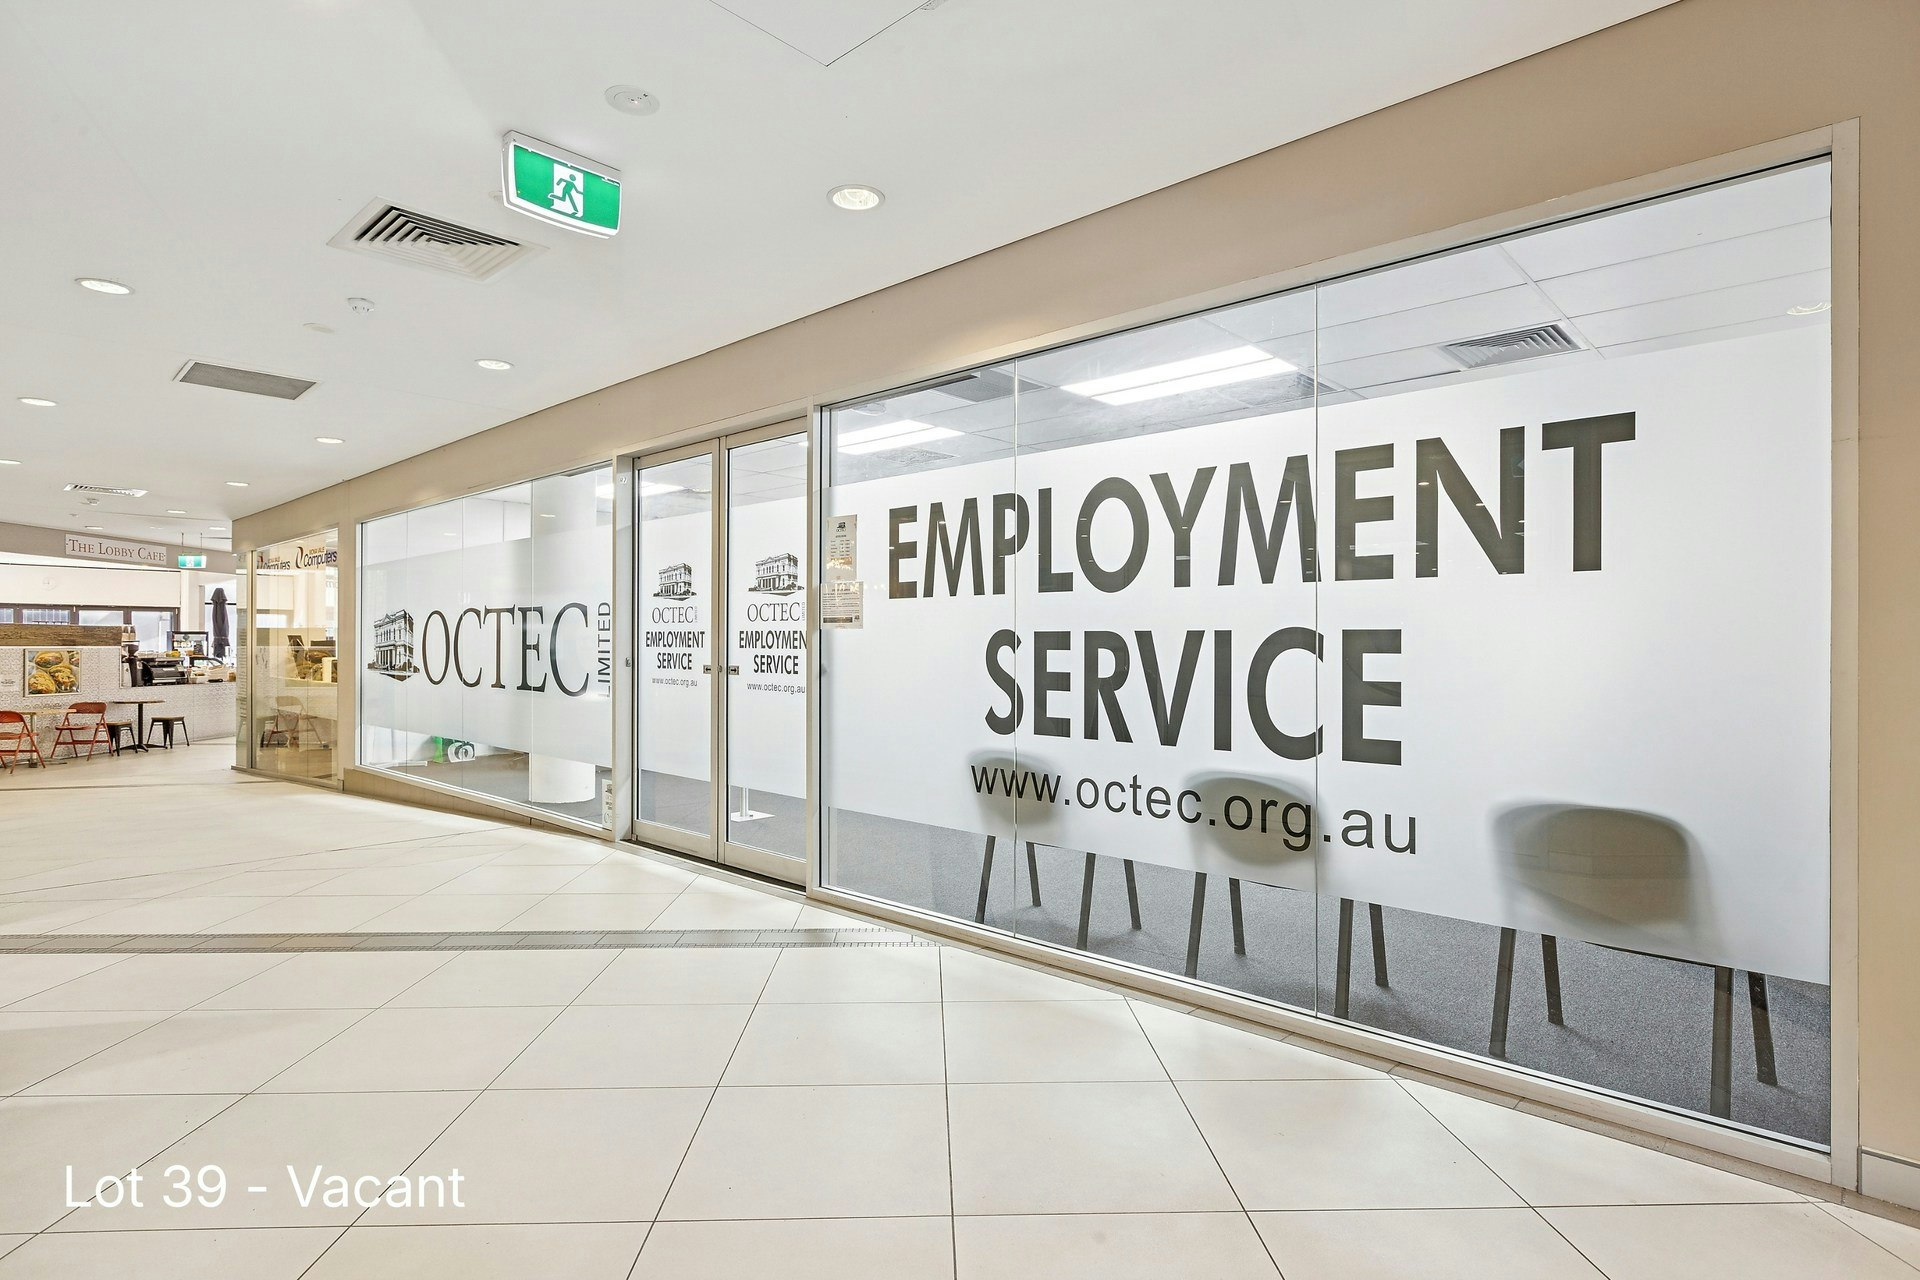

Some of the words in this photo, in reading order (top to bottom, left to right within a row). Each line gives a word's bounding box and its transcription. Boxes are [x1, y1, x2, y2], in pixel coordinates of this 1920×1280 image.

[889, 411, 1636, 600] EMPLOYMENT
[69, 538, 94, 554] THE
[98, 542, 135, 558] LOBBY
[138, 547, 164, 562] CAFE
[303, 551, 338, 568] Computers
[652, 606, 694, 624] OCTEC
[747, 601, 800, 622] OCTEC
[422, 602, 589, 697] OCTEC
[598, 601, 611, 698] LIMITED
[645, 630, 705, 649] EMPLOYMENT
[739, 629, 807, 650] EMPLOYMEN
[656, 652, 693, 670] SERVICE
[753, 654, 799, 675] SERVICE
[652, 677, 698, 689] www.octec.org.au
[747, 683, 806, 695] www.octec.org.au
[985, 626, 1402, 766] SERVICE
[970, 764, 1417, 856] www.octec.org.au
